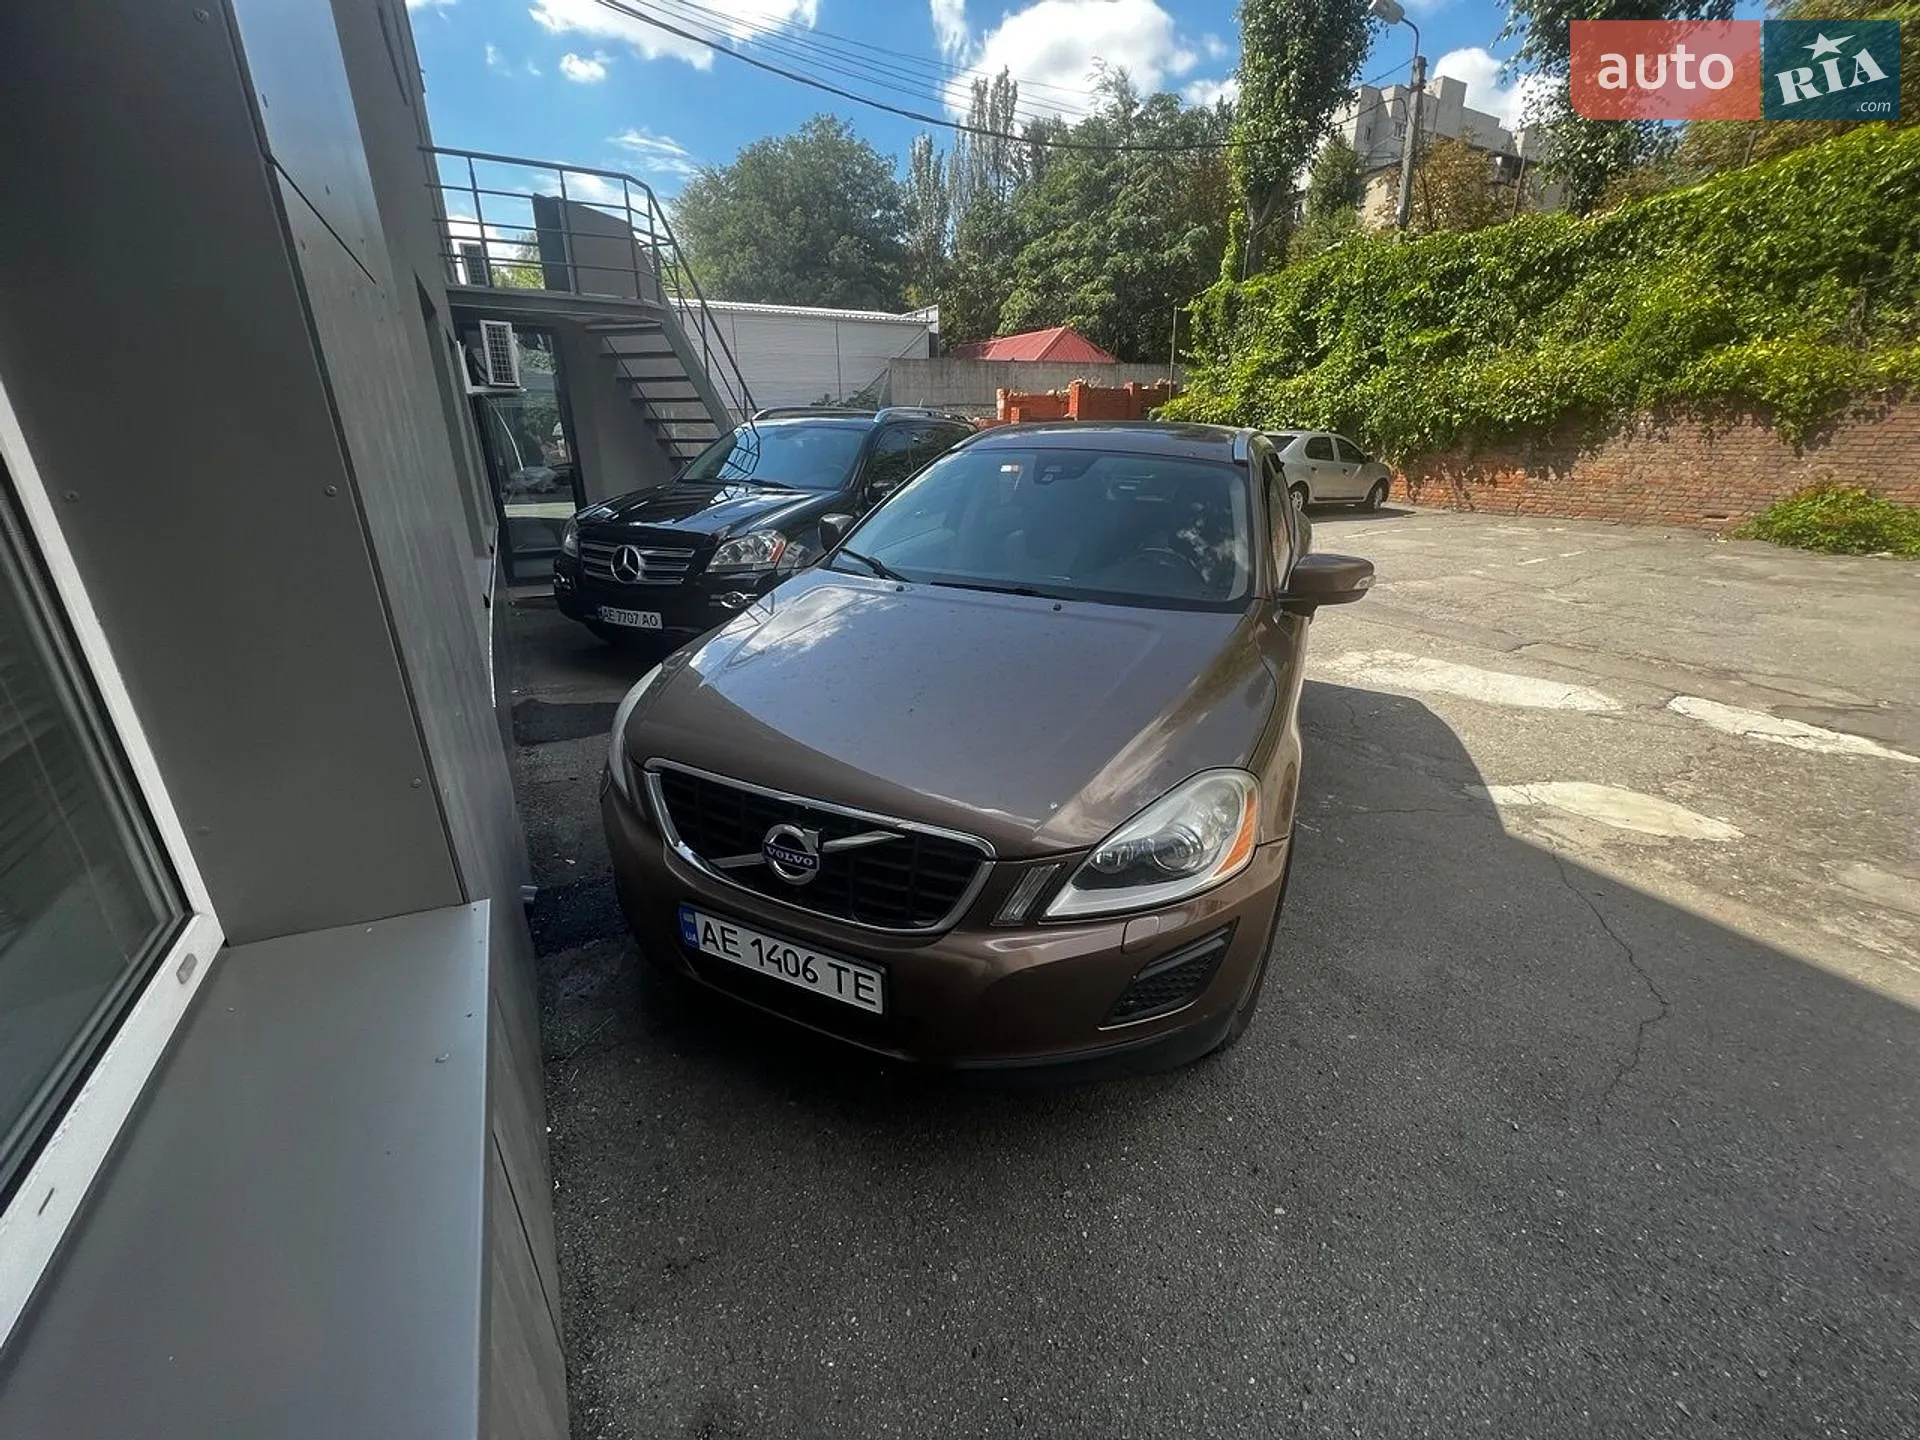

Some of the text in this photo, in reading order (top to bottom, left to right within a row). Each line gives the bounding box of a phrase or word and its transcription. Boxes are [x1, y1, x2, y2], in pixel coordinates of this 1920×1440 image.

[616, 611, 639, 624] 7707
[641, 614, 658, 627] AO
[766, 846, 814, 866] VOLVO
[685, 931, 698, 943] UA
[702, 920, 876, 1006] AE 1406 TE
